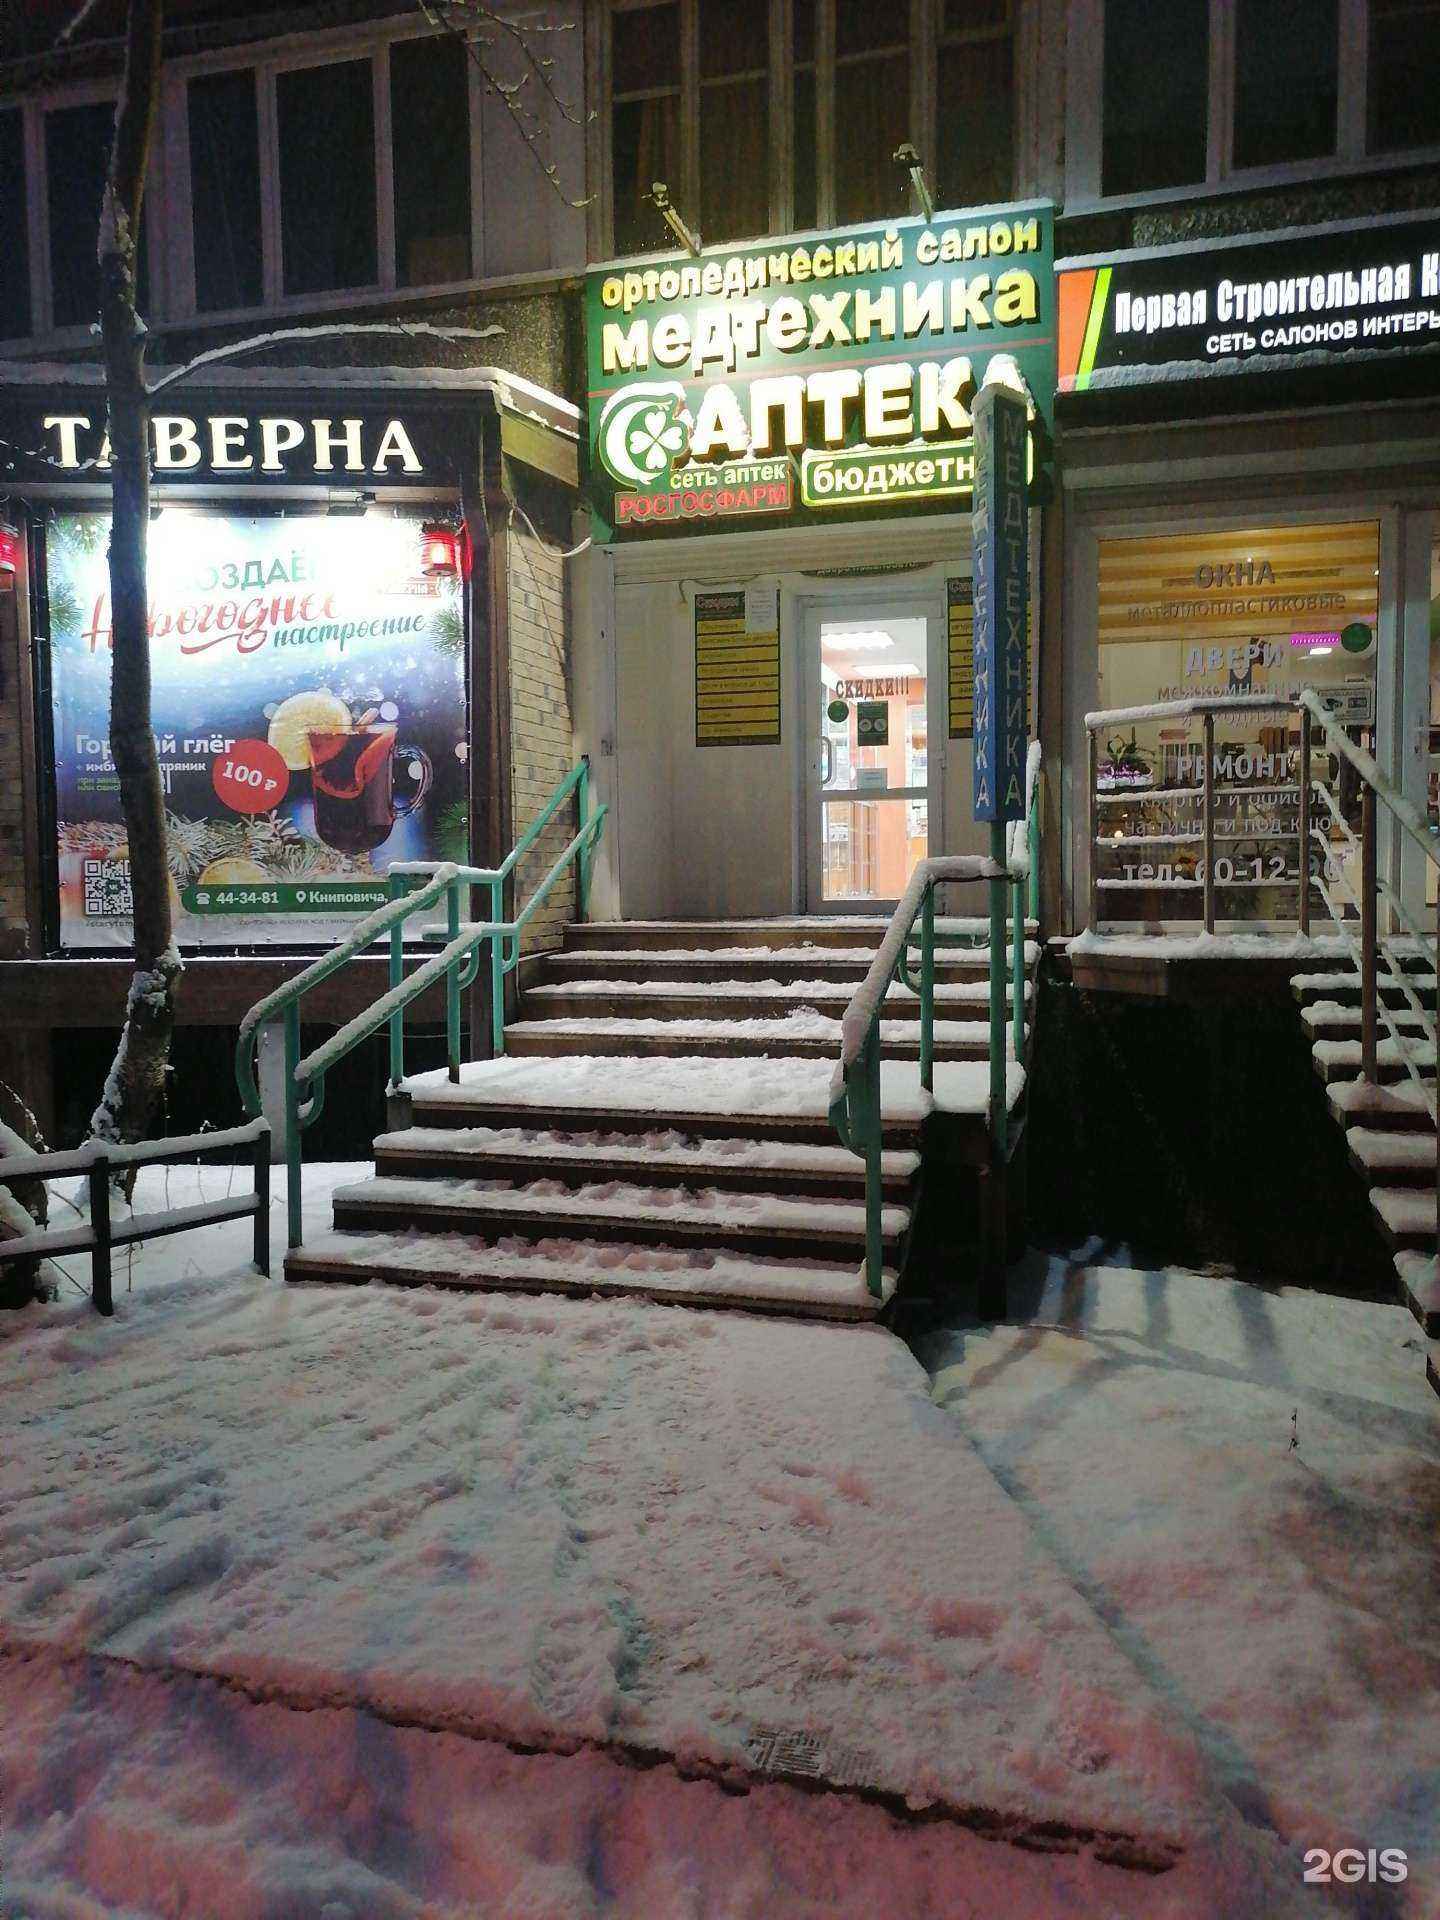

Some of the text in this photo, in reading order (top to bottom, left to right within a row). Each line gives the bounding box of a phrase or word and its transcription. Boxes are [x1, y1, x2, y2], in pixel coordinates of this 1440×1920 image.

[602, 217, 1040, 313] ортопедический салон
[1115, 252, 1440, 334] Первая Строительная К
[602, 267, 1040, 377] медтехника
[1206, 310, 1440, 355] СЕТЬ САЛОНОВ ИНТЕРЬ
[670, 463, 786, 489] сеть аптек
[813, 456, 976, 498] бюджетн
[618, 483, 788, 518] РОСГОСФАРМ
[186, 549, 316, 592] ОЗДАЁ
[1195, 559, 1277, 590] ОКНА
[81, 592, 338, 654] Нвогоднее
[973, 413, 992, 808] ЕДТЕХНИКА
[1127, 593, 1346, 622] металлопластиковые
[273, 614, 426, 652] настроение
[1185, 638, 1285, 677] ДВЕРИ
[836, 676, 908, 700] СКИДКИ!!!
[76, 734, 236, 760] Горй глёг
[1177, 752, 1289, 781] РЕМОНТ
[1125, 816, 1216, 836] частичн
[1245, 817, 1282, 834] под
[216, 891, 388, 904] 44-34-81 Книповича,
